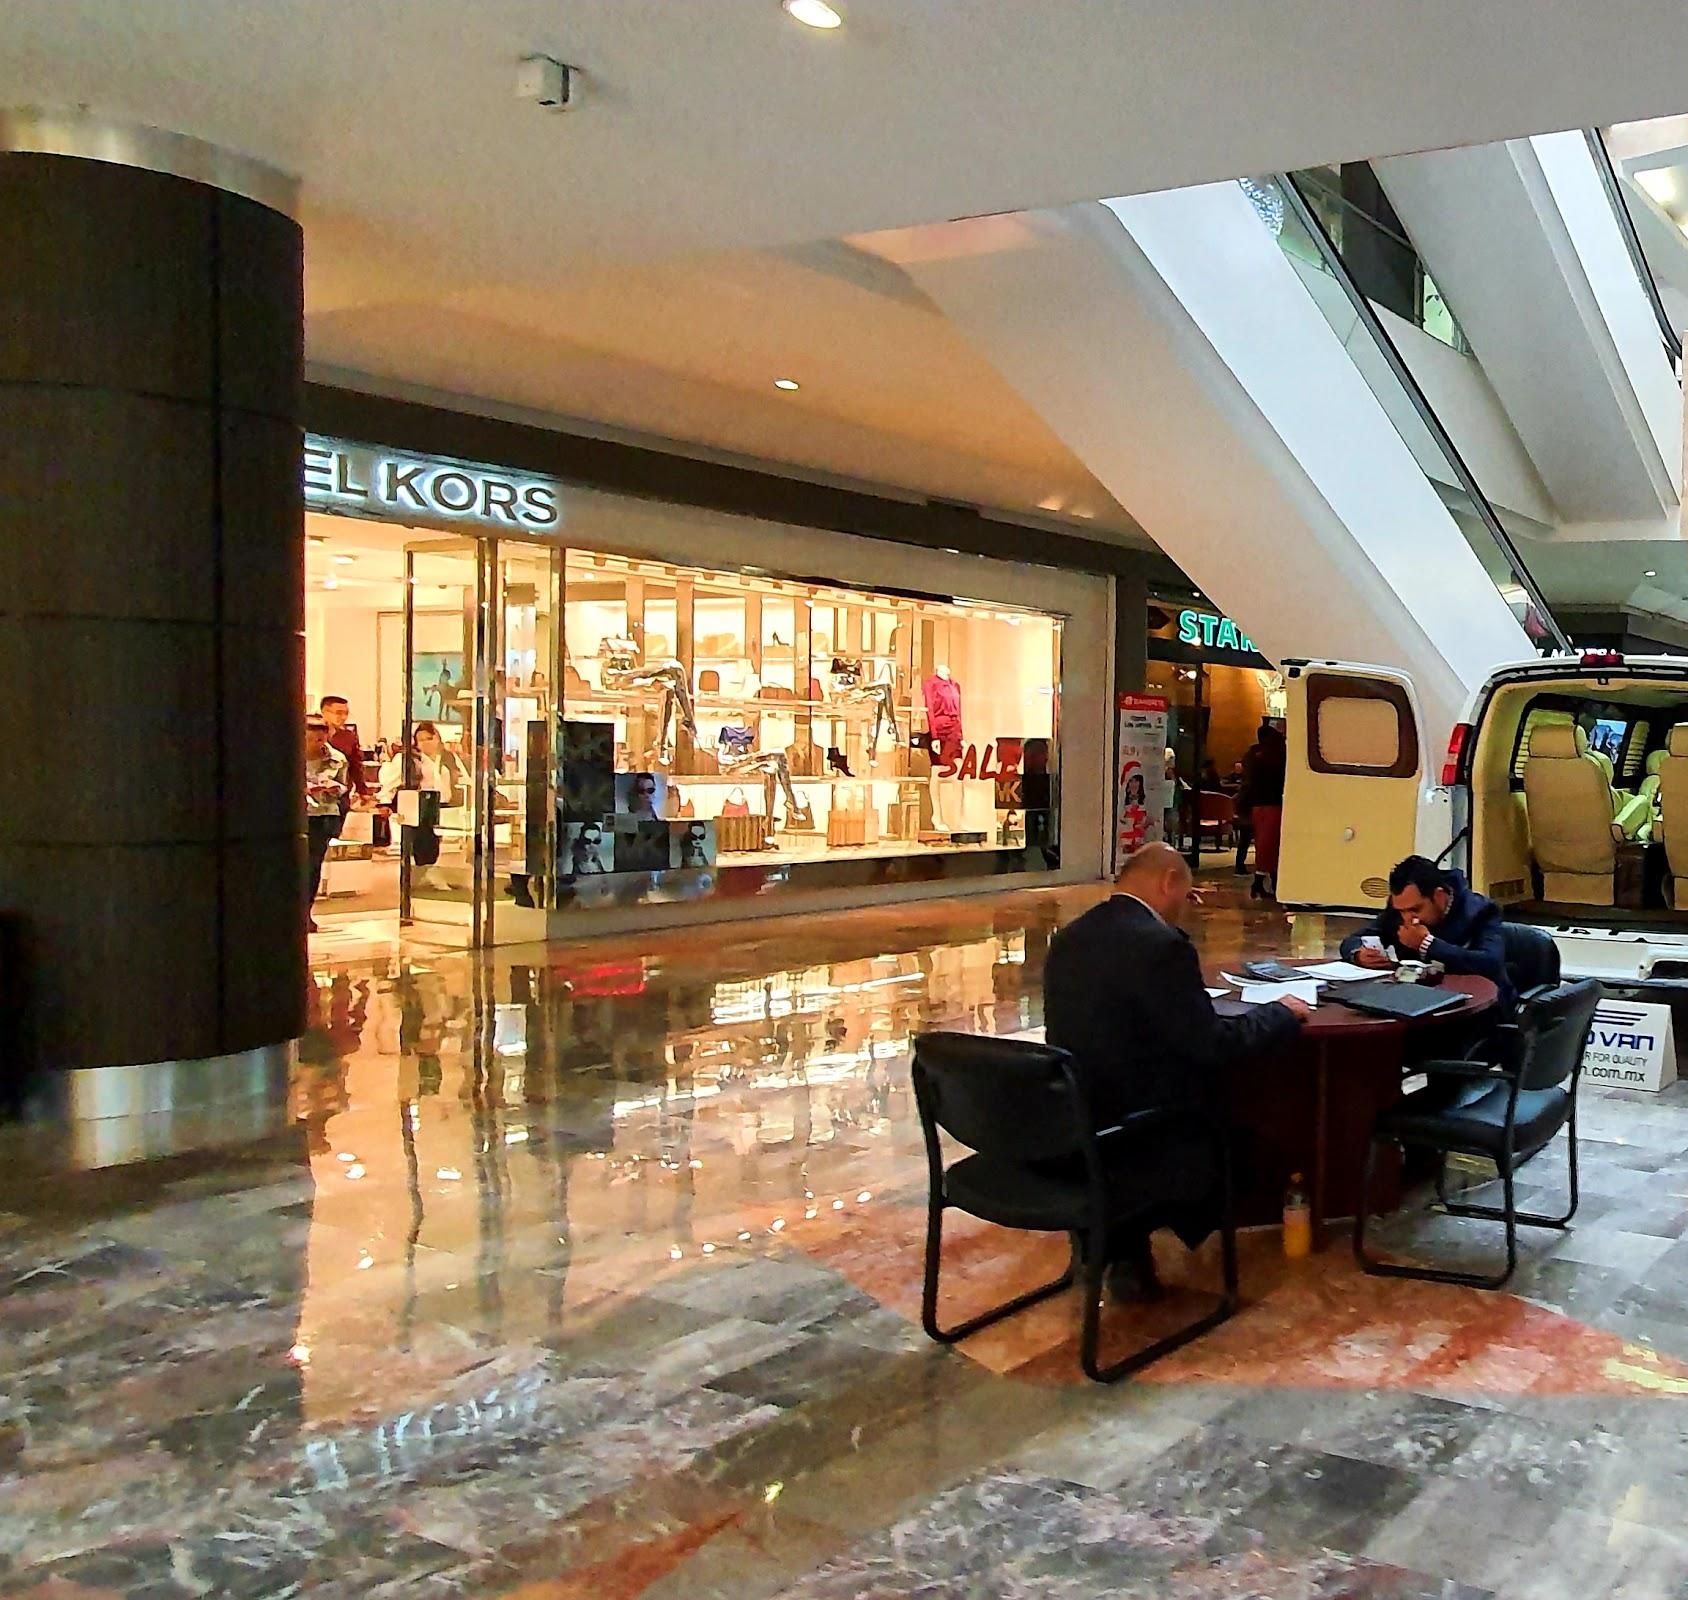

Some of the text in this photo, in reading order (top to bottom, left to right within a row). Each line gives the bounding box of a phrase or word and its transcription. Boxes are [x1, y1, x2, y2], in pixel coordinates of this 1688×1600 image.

[386, 463, 558, 524] KORS
[1600, 1031, 1655, 1052] VAN
[1593, 1052, 1610, 1063] FOR
[1612, 1054, 1648, 1067] QUALITY
